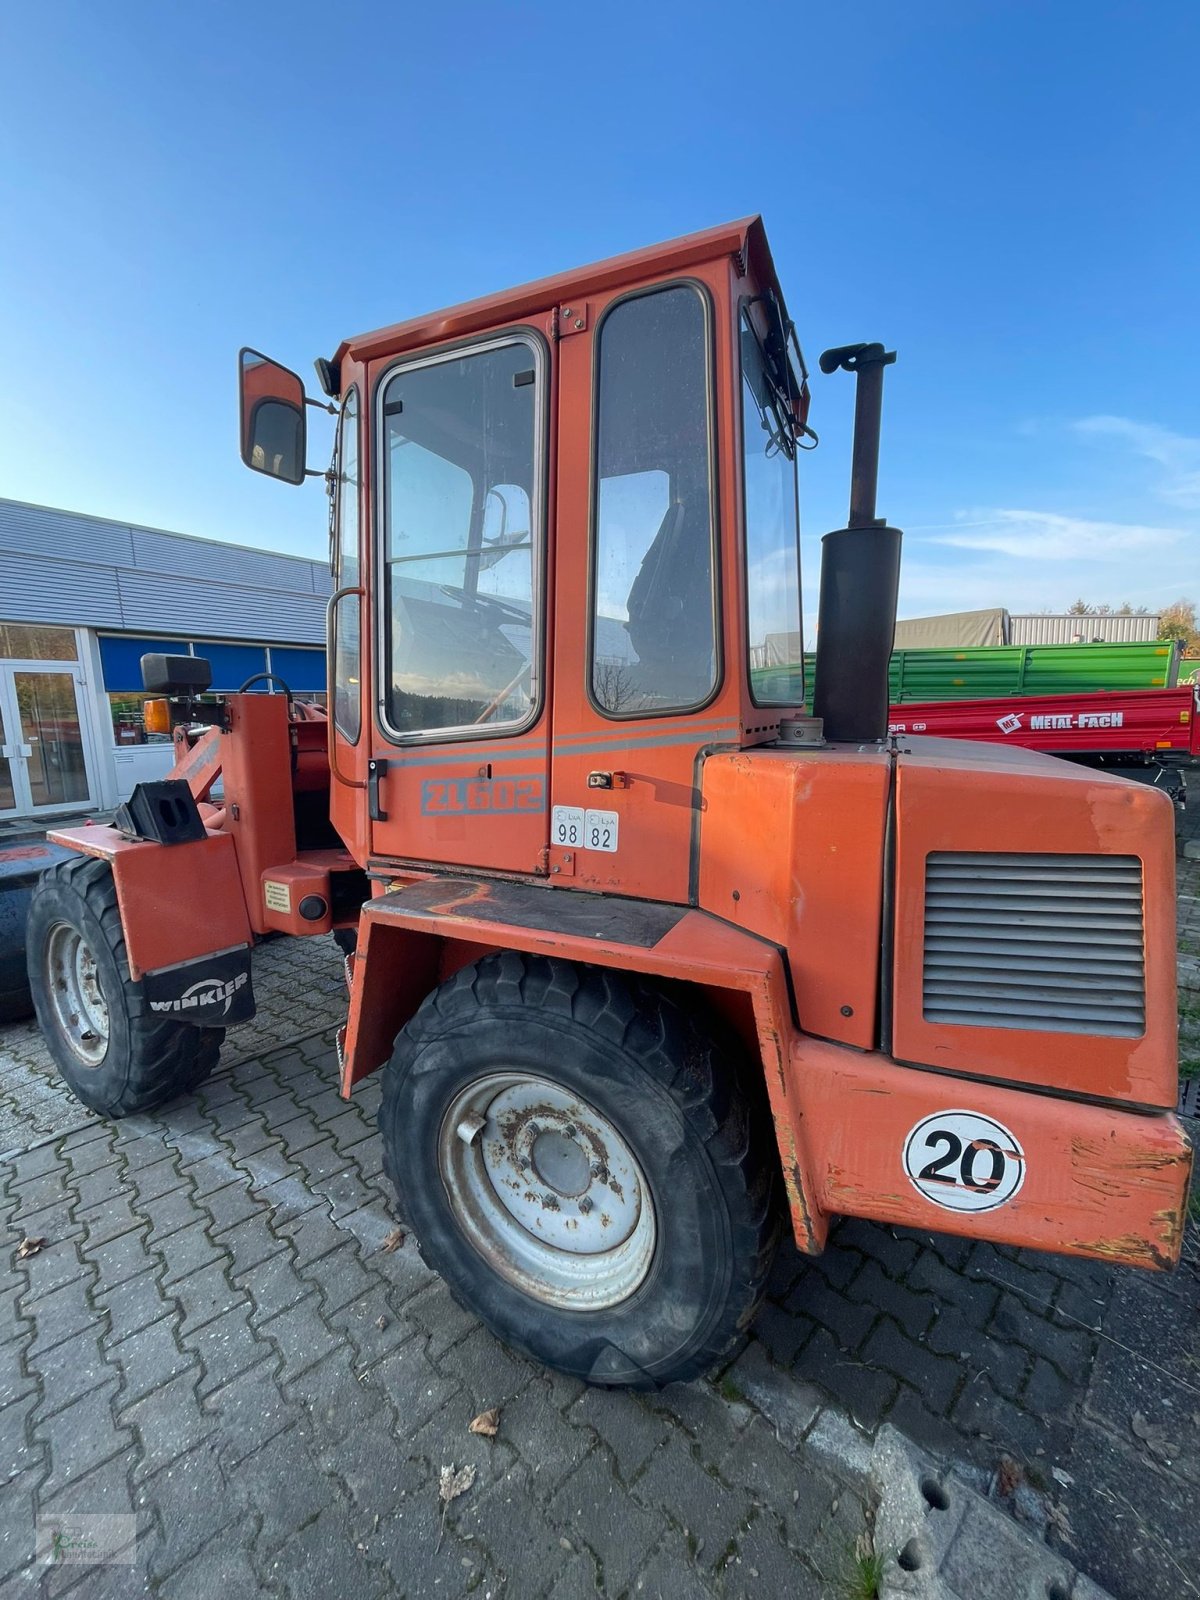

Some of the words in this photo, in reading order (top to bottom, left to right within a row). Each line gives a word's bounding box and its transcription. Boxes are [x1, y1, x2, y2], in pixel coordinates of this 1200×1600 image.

[1177, 675, 1195, 686] ech
[425, 781, 542, 811] ZL602
[559, 824, 577, 844] 98
[592, 828, 611, 848] 82
[150, 972, 248, 1012] WINKLER
[919, 1130, 1005, 1194] 20
